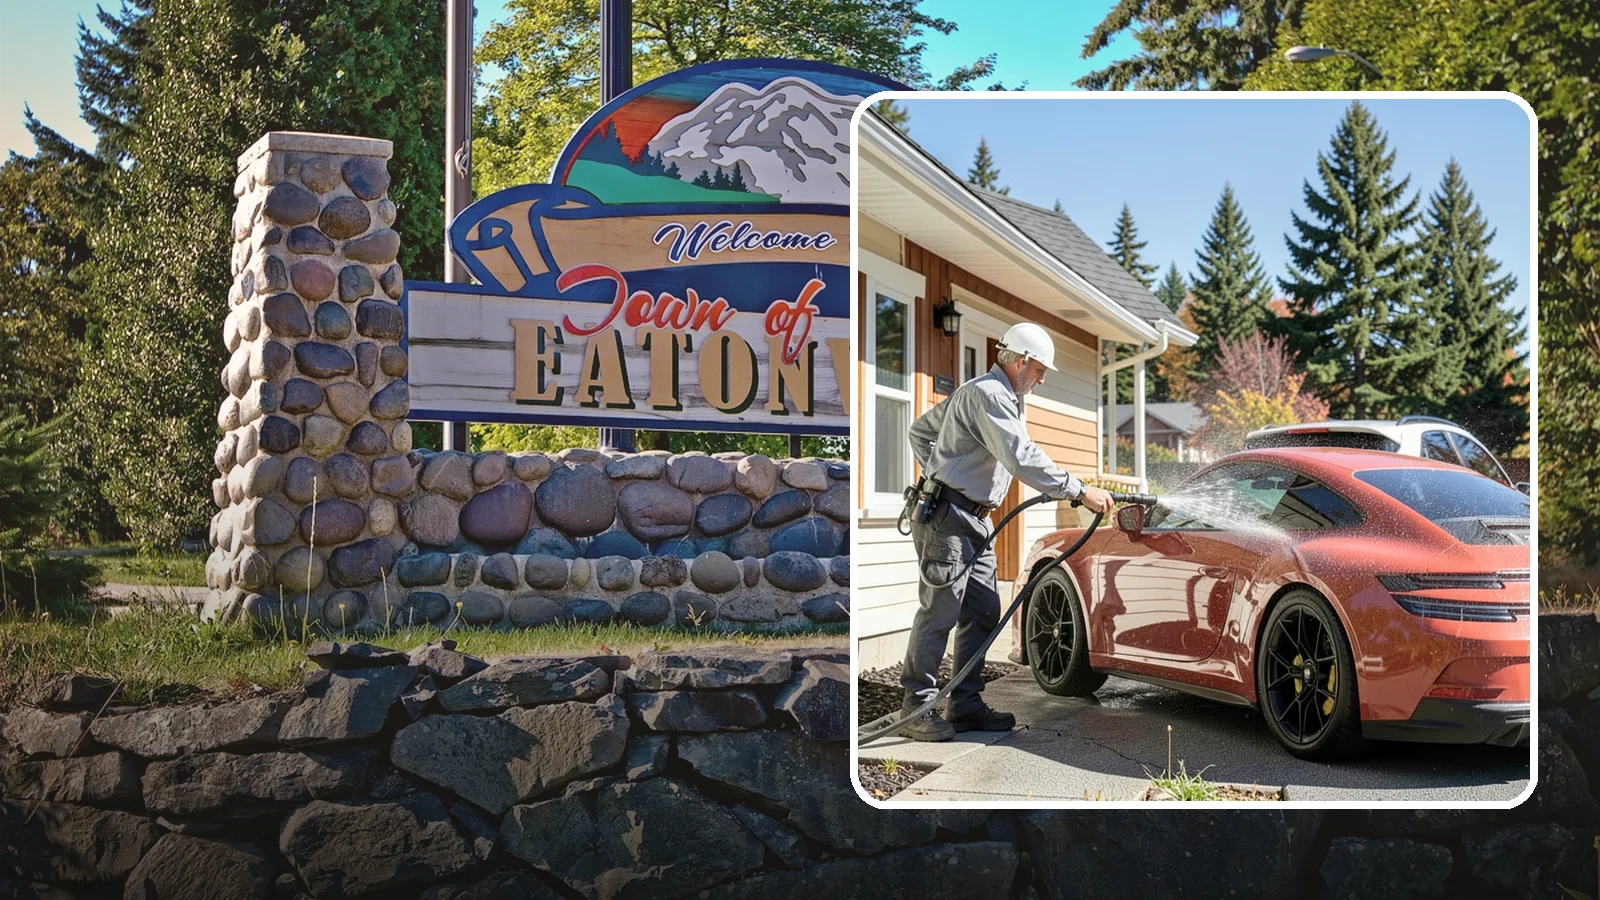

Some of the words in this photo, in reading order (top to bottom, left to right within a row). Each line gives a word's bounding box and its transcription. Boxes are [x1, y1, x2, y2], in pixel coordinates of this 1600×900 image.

[653, 220, 836, 263] Welcome
[556, 263, 737, 336] Town
[765, 278, 826, 365] of
